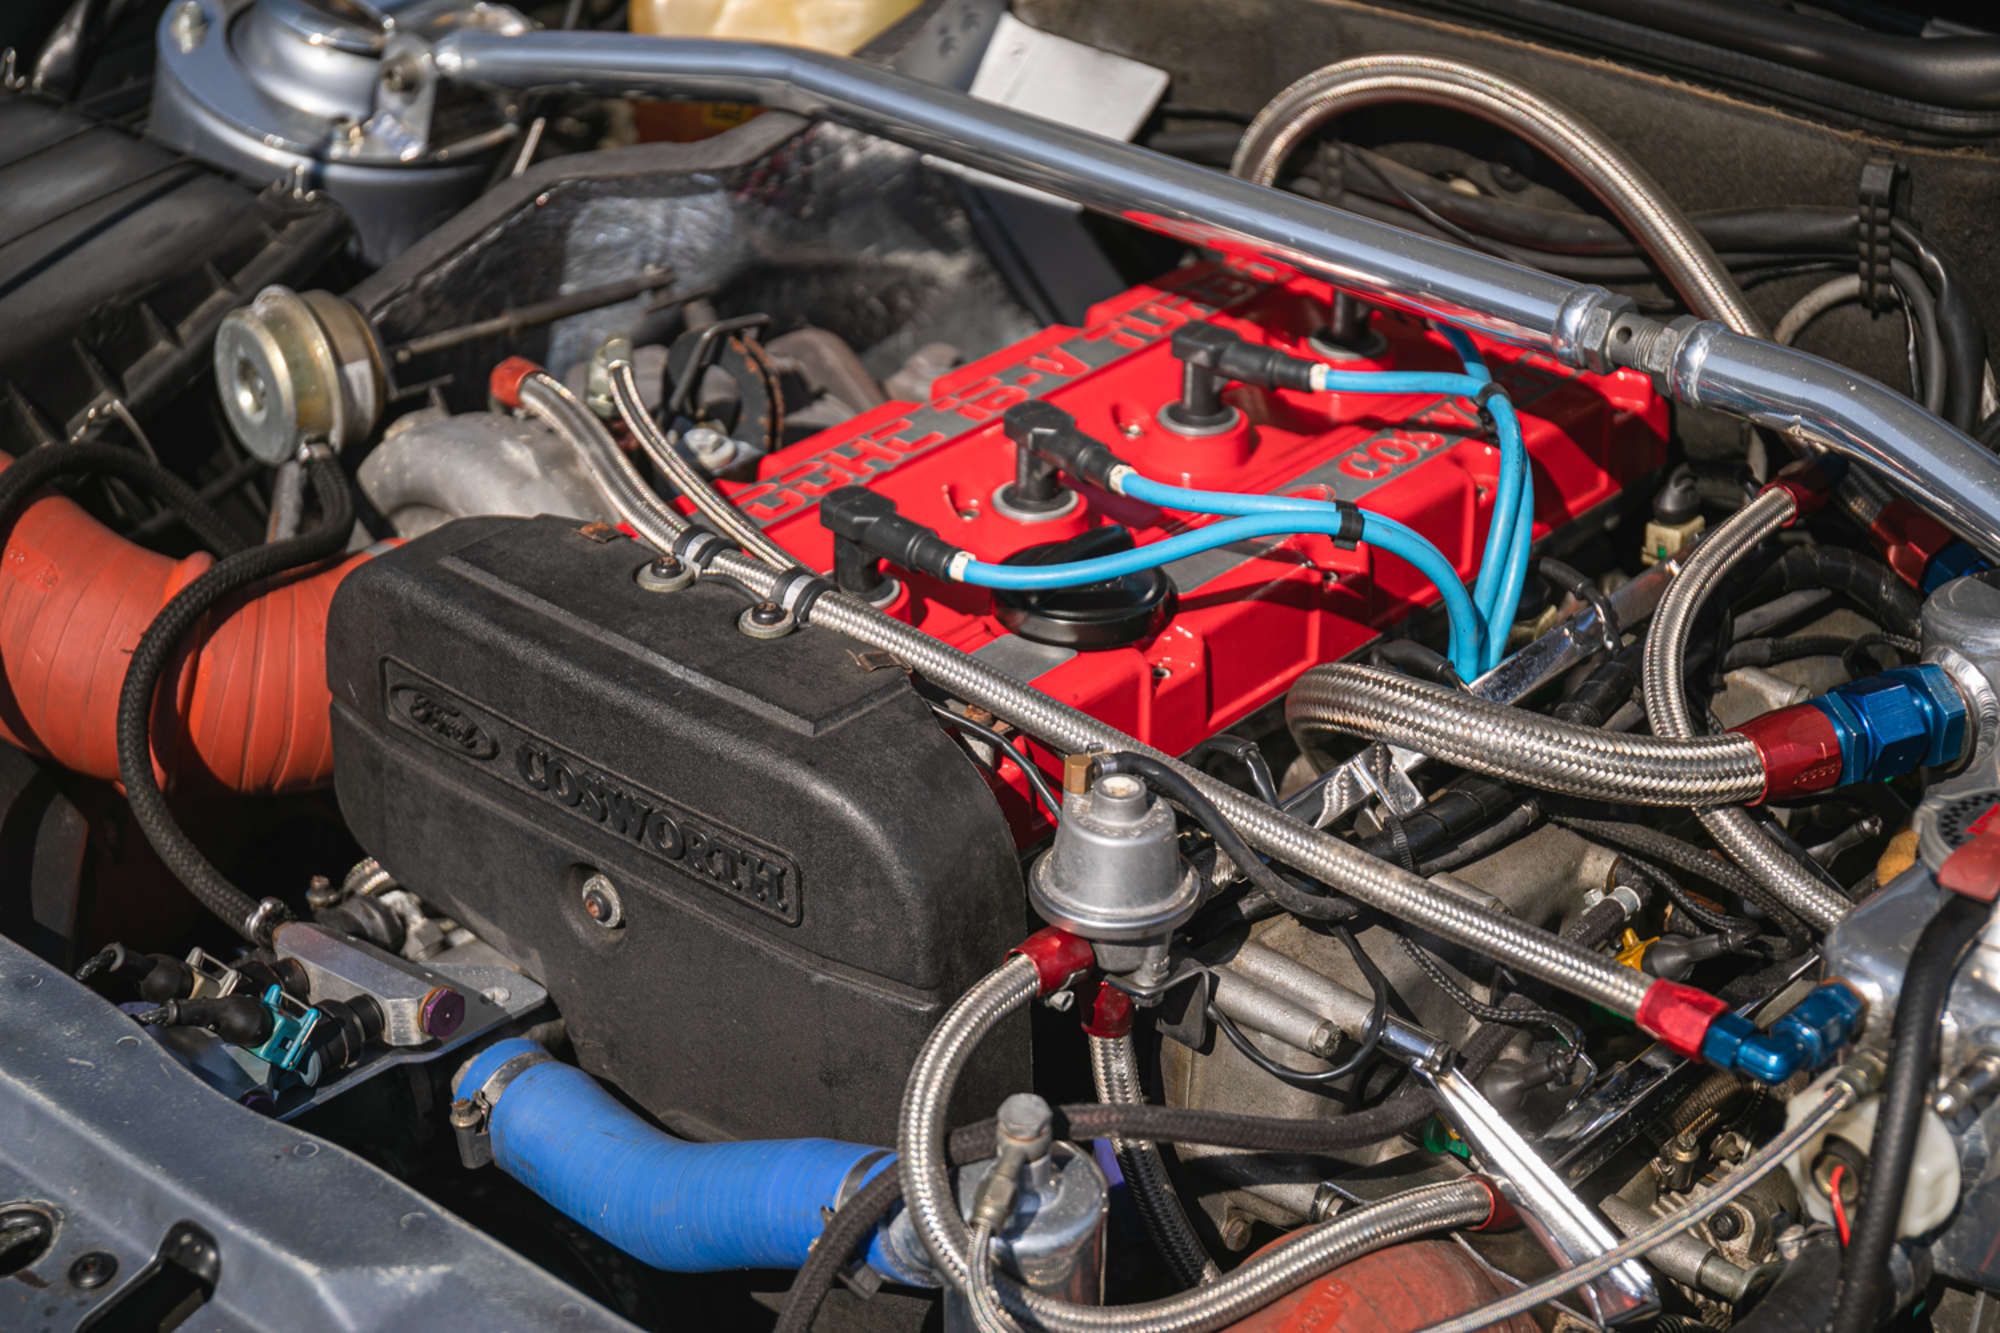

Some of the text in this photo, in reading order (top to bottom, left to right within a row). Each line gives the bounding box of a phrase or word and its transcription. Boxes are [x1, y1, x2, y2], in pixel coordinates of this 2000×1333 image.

[733, 417, 946, 521] DOHC
[931, 345, 1091, 421] 16-V
[515, 742, 788, 912] COSWORTH
